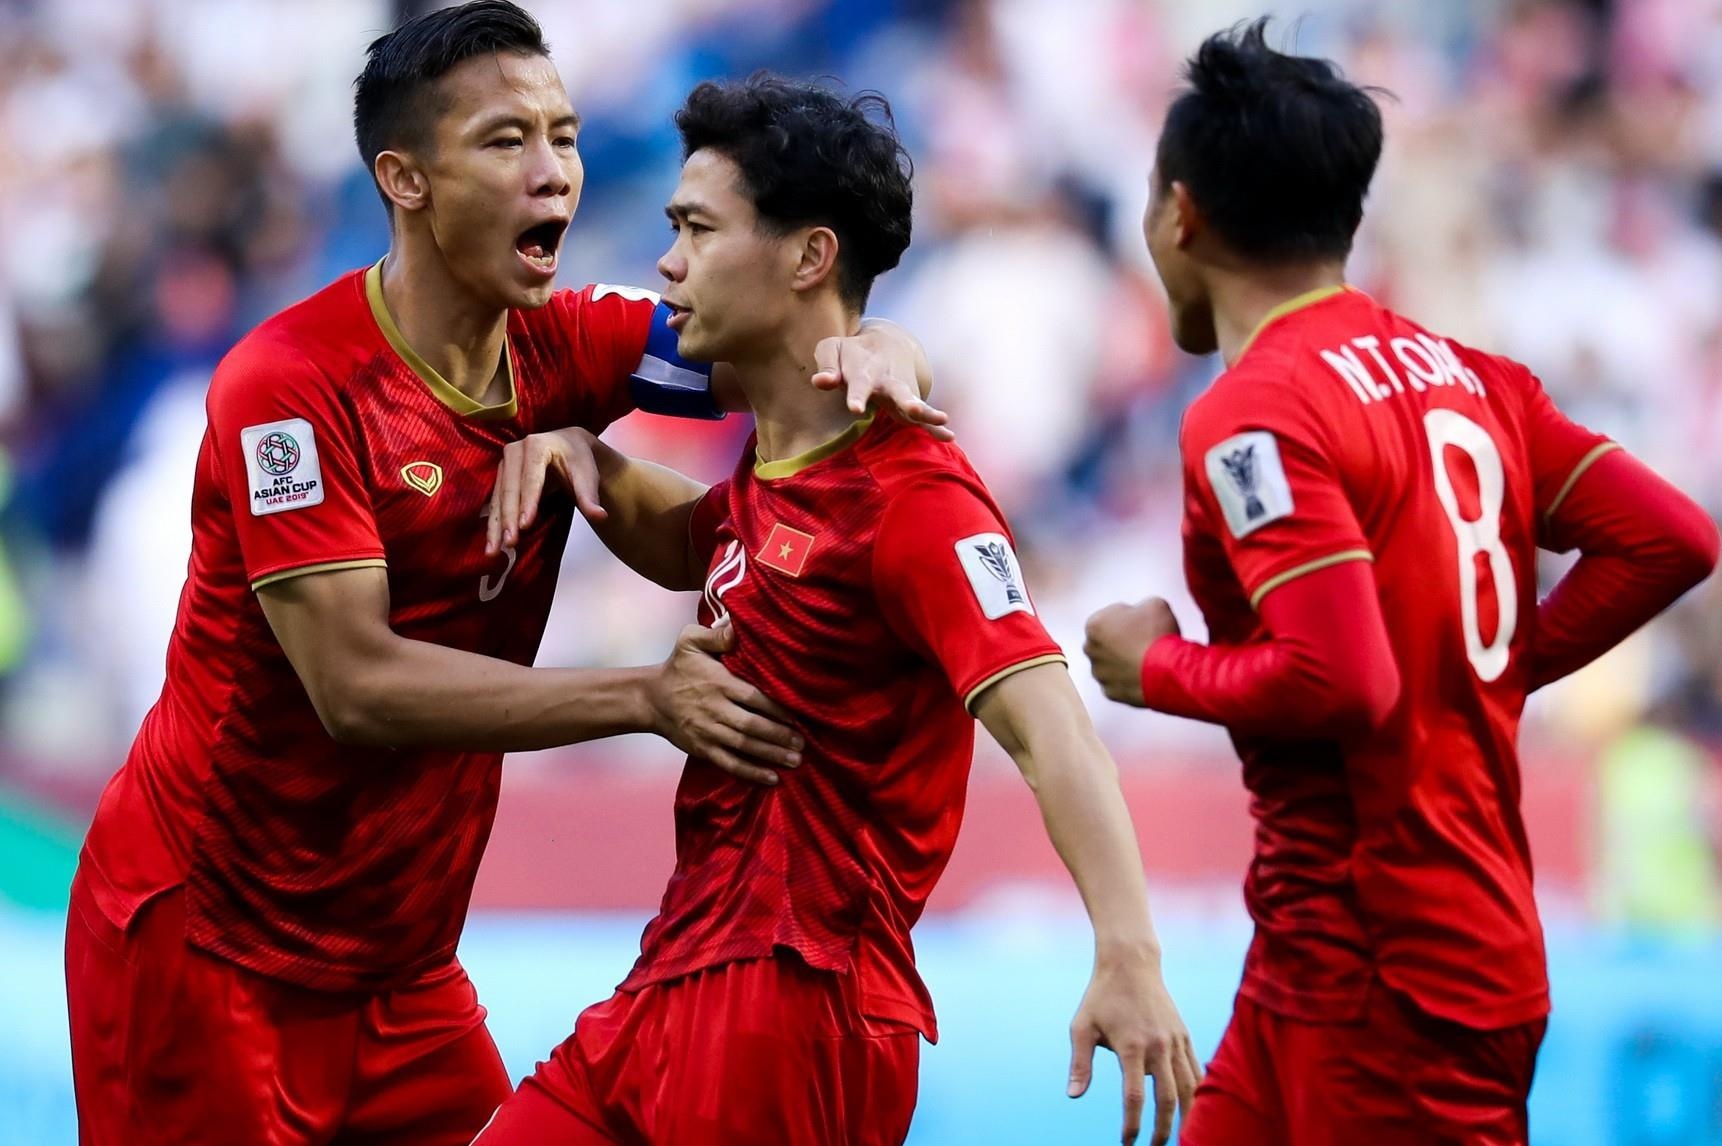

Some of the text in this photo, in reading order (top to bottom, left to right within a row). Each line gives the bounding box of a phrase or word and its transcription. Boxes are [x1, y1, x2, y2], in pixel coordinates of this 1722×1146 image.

[273, 476, 293, 486] AFC
[254, 480, 317, 500] ASIAN CUP
[266, 496, 284, 505] UAE
[1423, 408, 1518, 683] 8
